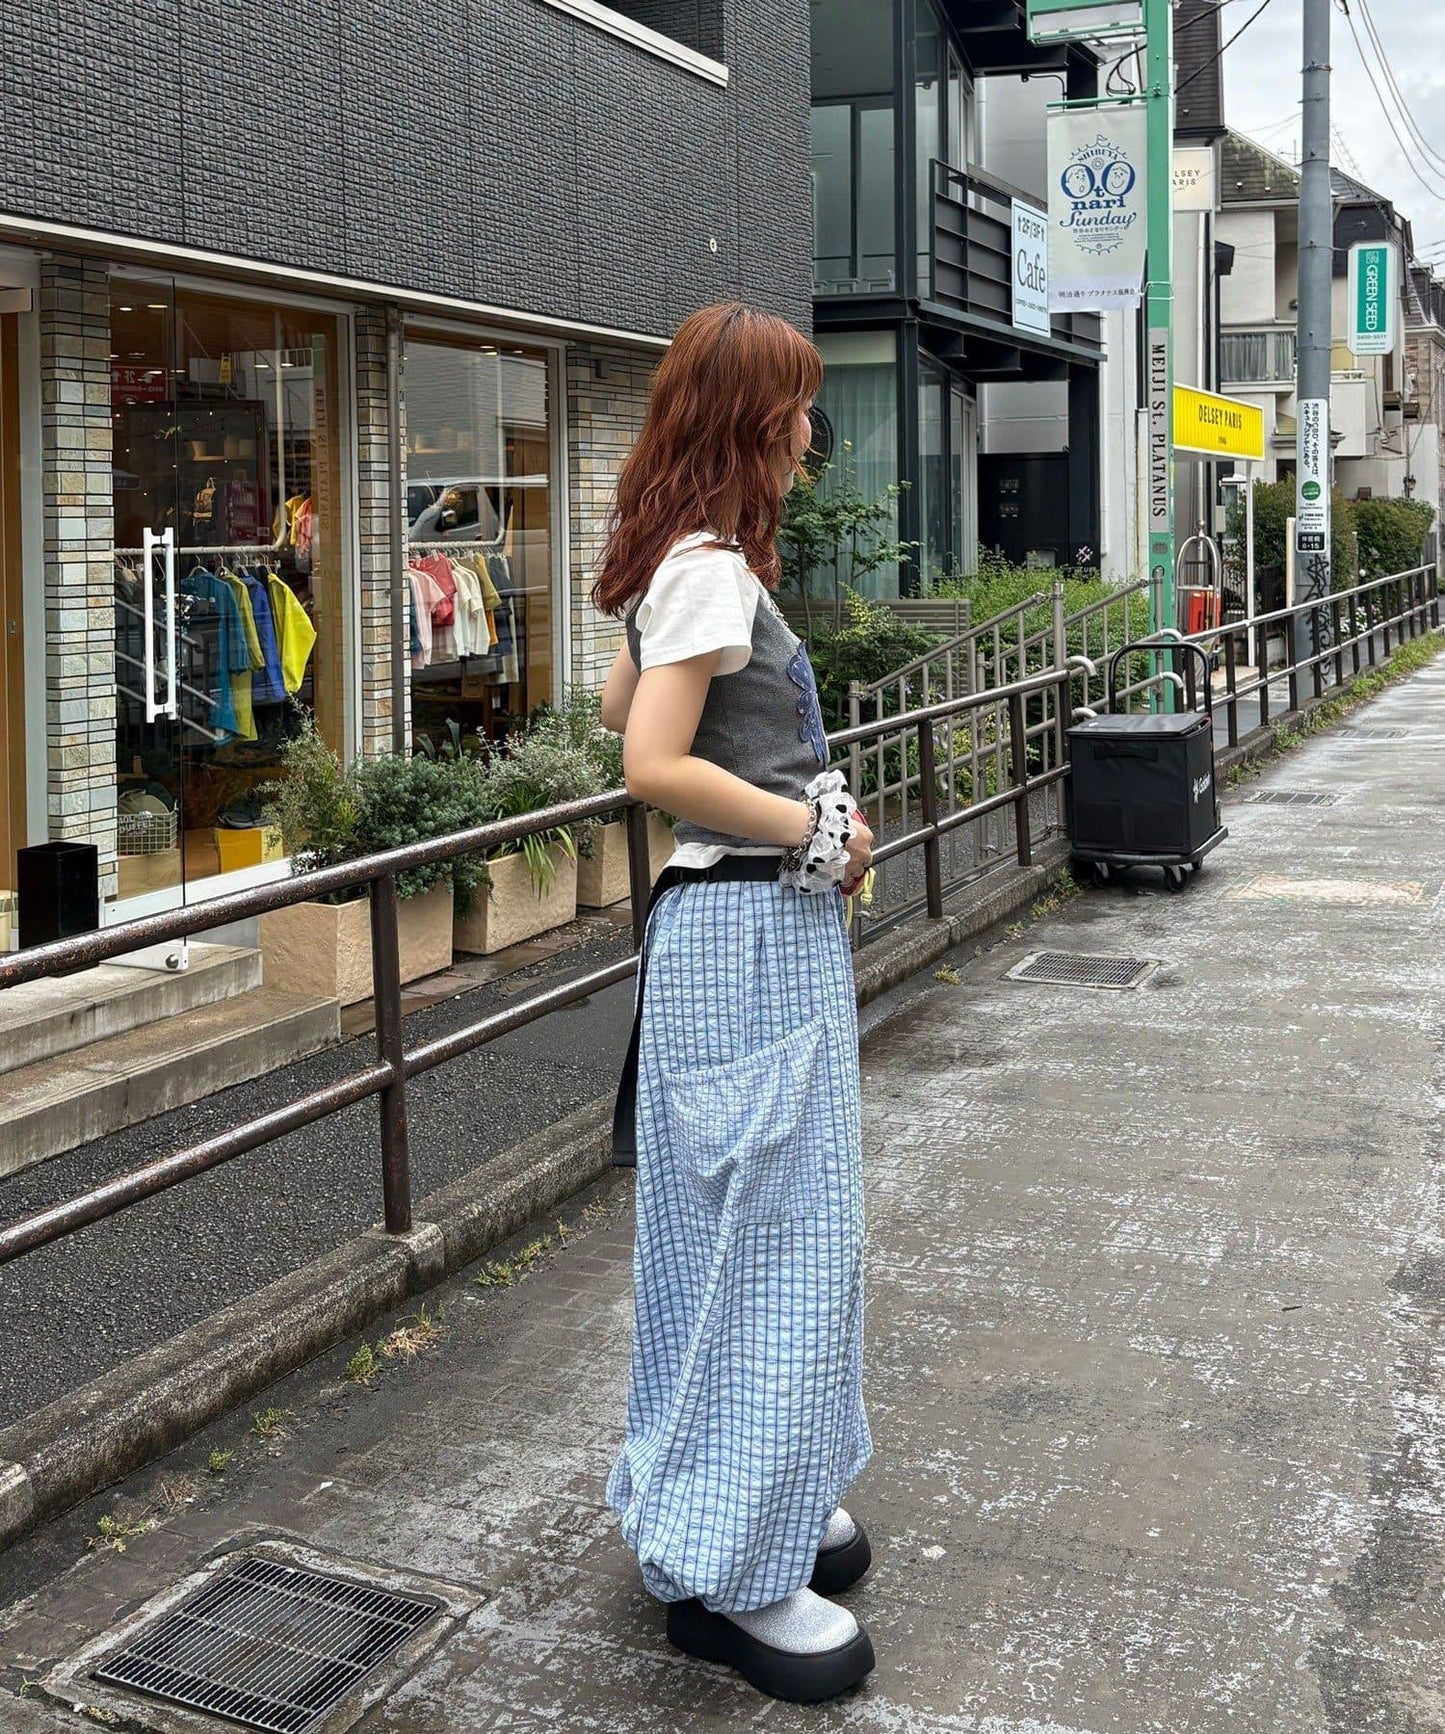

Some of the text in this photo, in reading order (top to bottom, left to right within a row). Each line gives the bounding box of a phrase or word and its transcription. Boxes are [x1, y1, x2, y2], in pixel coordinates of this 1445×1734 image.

[1174, 169, 1200, 177] LSEY
[1071, 196, 1126, 211] nari
[1060, 210, 1137, 230] Sunday
[1017, 249, 1046, 293] Cafe
[1366, 265, 1378, 331] GREEN SEED
[1198, 403, 1242, 430] DELSEY PARIS
[1152, 344, 1167, 517] MEIJI St. PLATANUS
